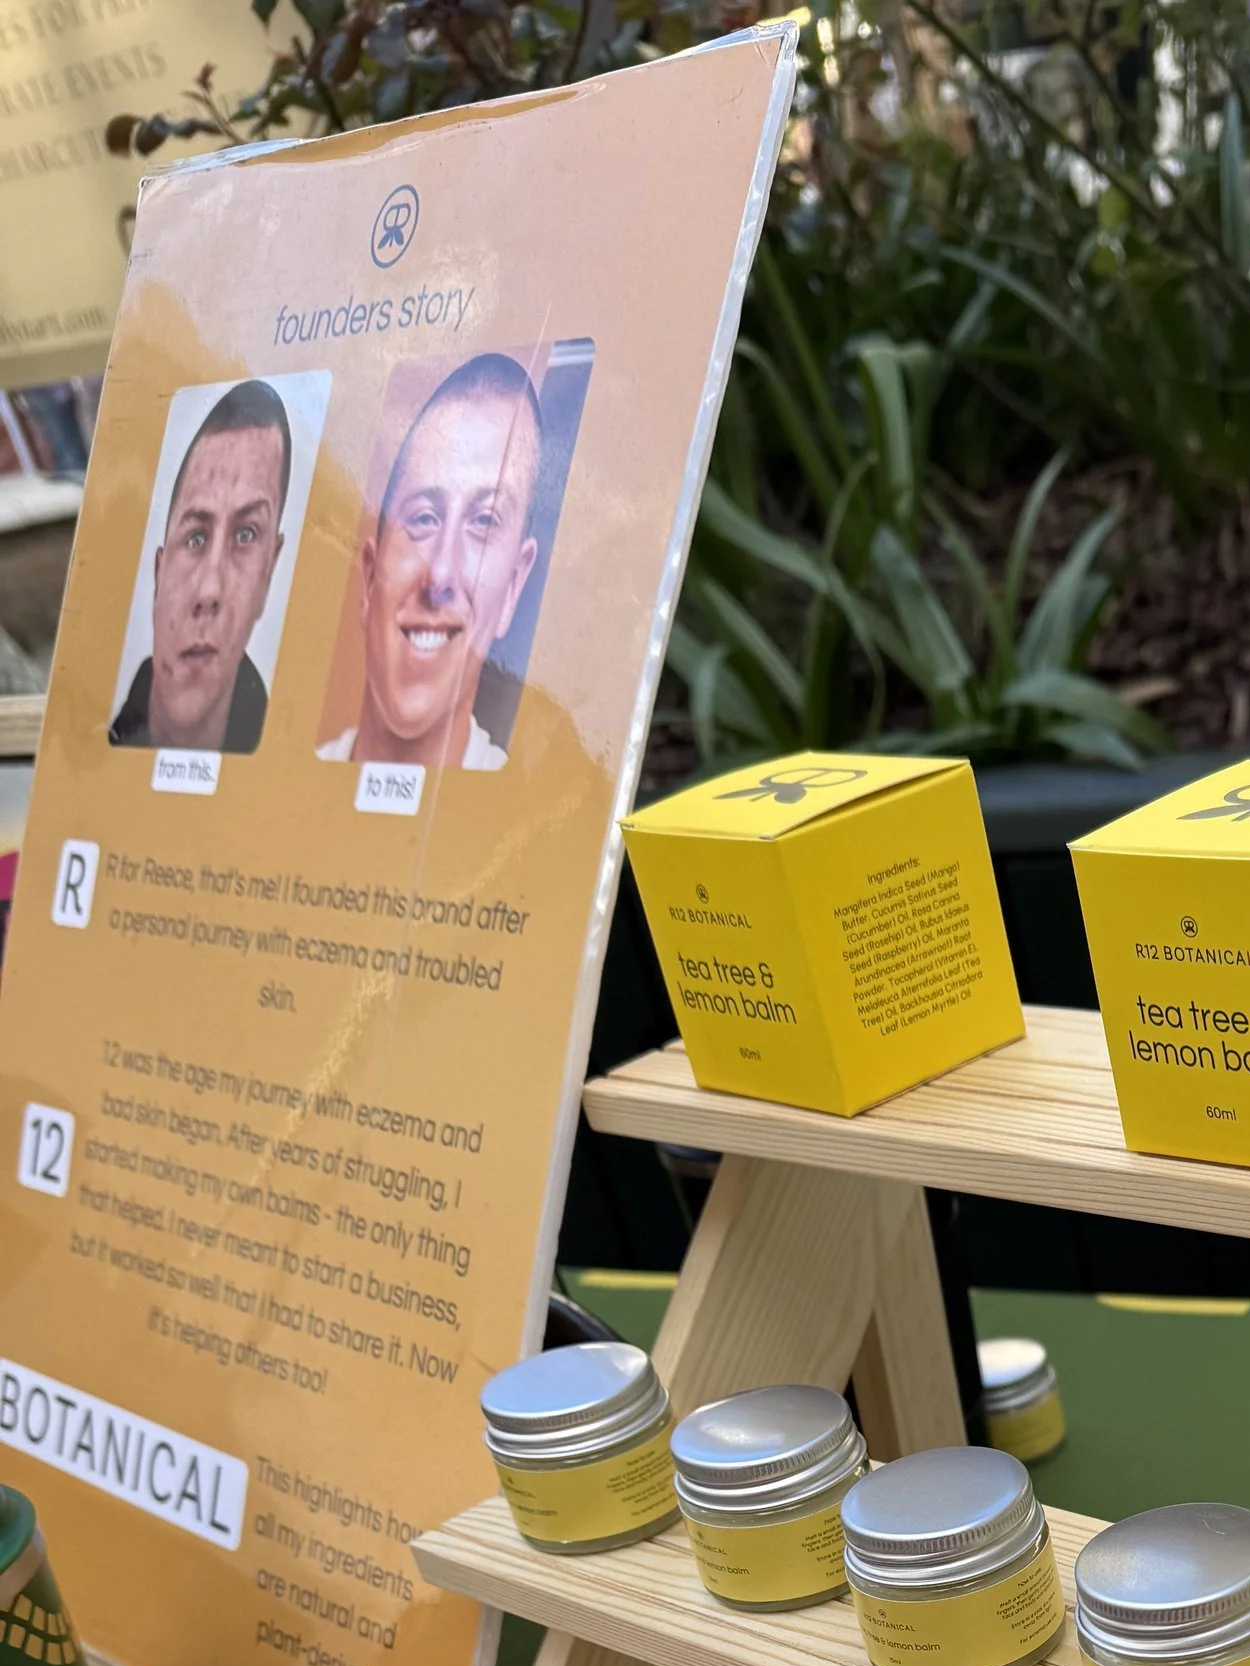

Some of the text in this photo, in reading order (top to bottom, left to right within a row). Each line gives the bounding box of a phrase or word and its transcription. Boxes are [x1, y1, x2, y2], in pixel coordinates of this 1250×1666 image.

[273, 286, 476, 345] founders story
[62, 853, 85, 915] R
[107, 853, 119, 877] R
[119, 855, 140, 882] for
[200, 866, 246, 897] that's
[247, 876, 282, 901] me!
[291, 875, 370, 913] founded
[372, 886, 408, 919] this
[410, 893, 475, 928] brand
[476, 899, 530, 935] after
[669, 907, 751, 928] R12 BOTANICAL
[109, 909, 504, 991] a personal journey with eczema and troubled
[678, 952, 774, 988] tea tree &
[1135, 944, 1160, 960] R12
[677, 982, 797, 1024] lemon balm
[1137, 996, 1181, 1029] tea
[1189, 1001, 1250, 1034] tree
[739, 1047, 761, 1061] 60ml
[1129, 1032, 1216, 1069] lemon
[1206, 1106, 1237, 1121] 60ml
[27, 1118, 64, 1184] 12
[0, 1372, 231, 1535] BOTANICAL
[256, 1454, 290, 1493] This
[294, 1473, 383, 1532] highlights
[254, 1513, 414, 1602] all my ingredients
[256, 1568, 398, 1650] are natural and
